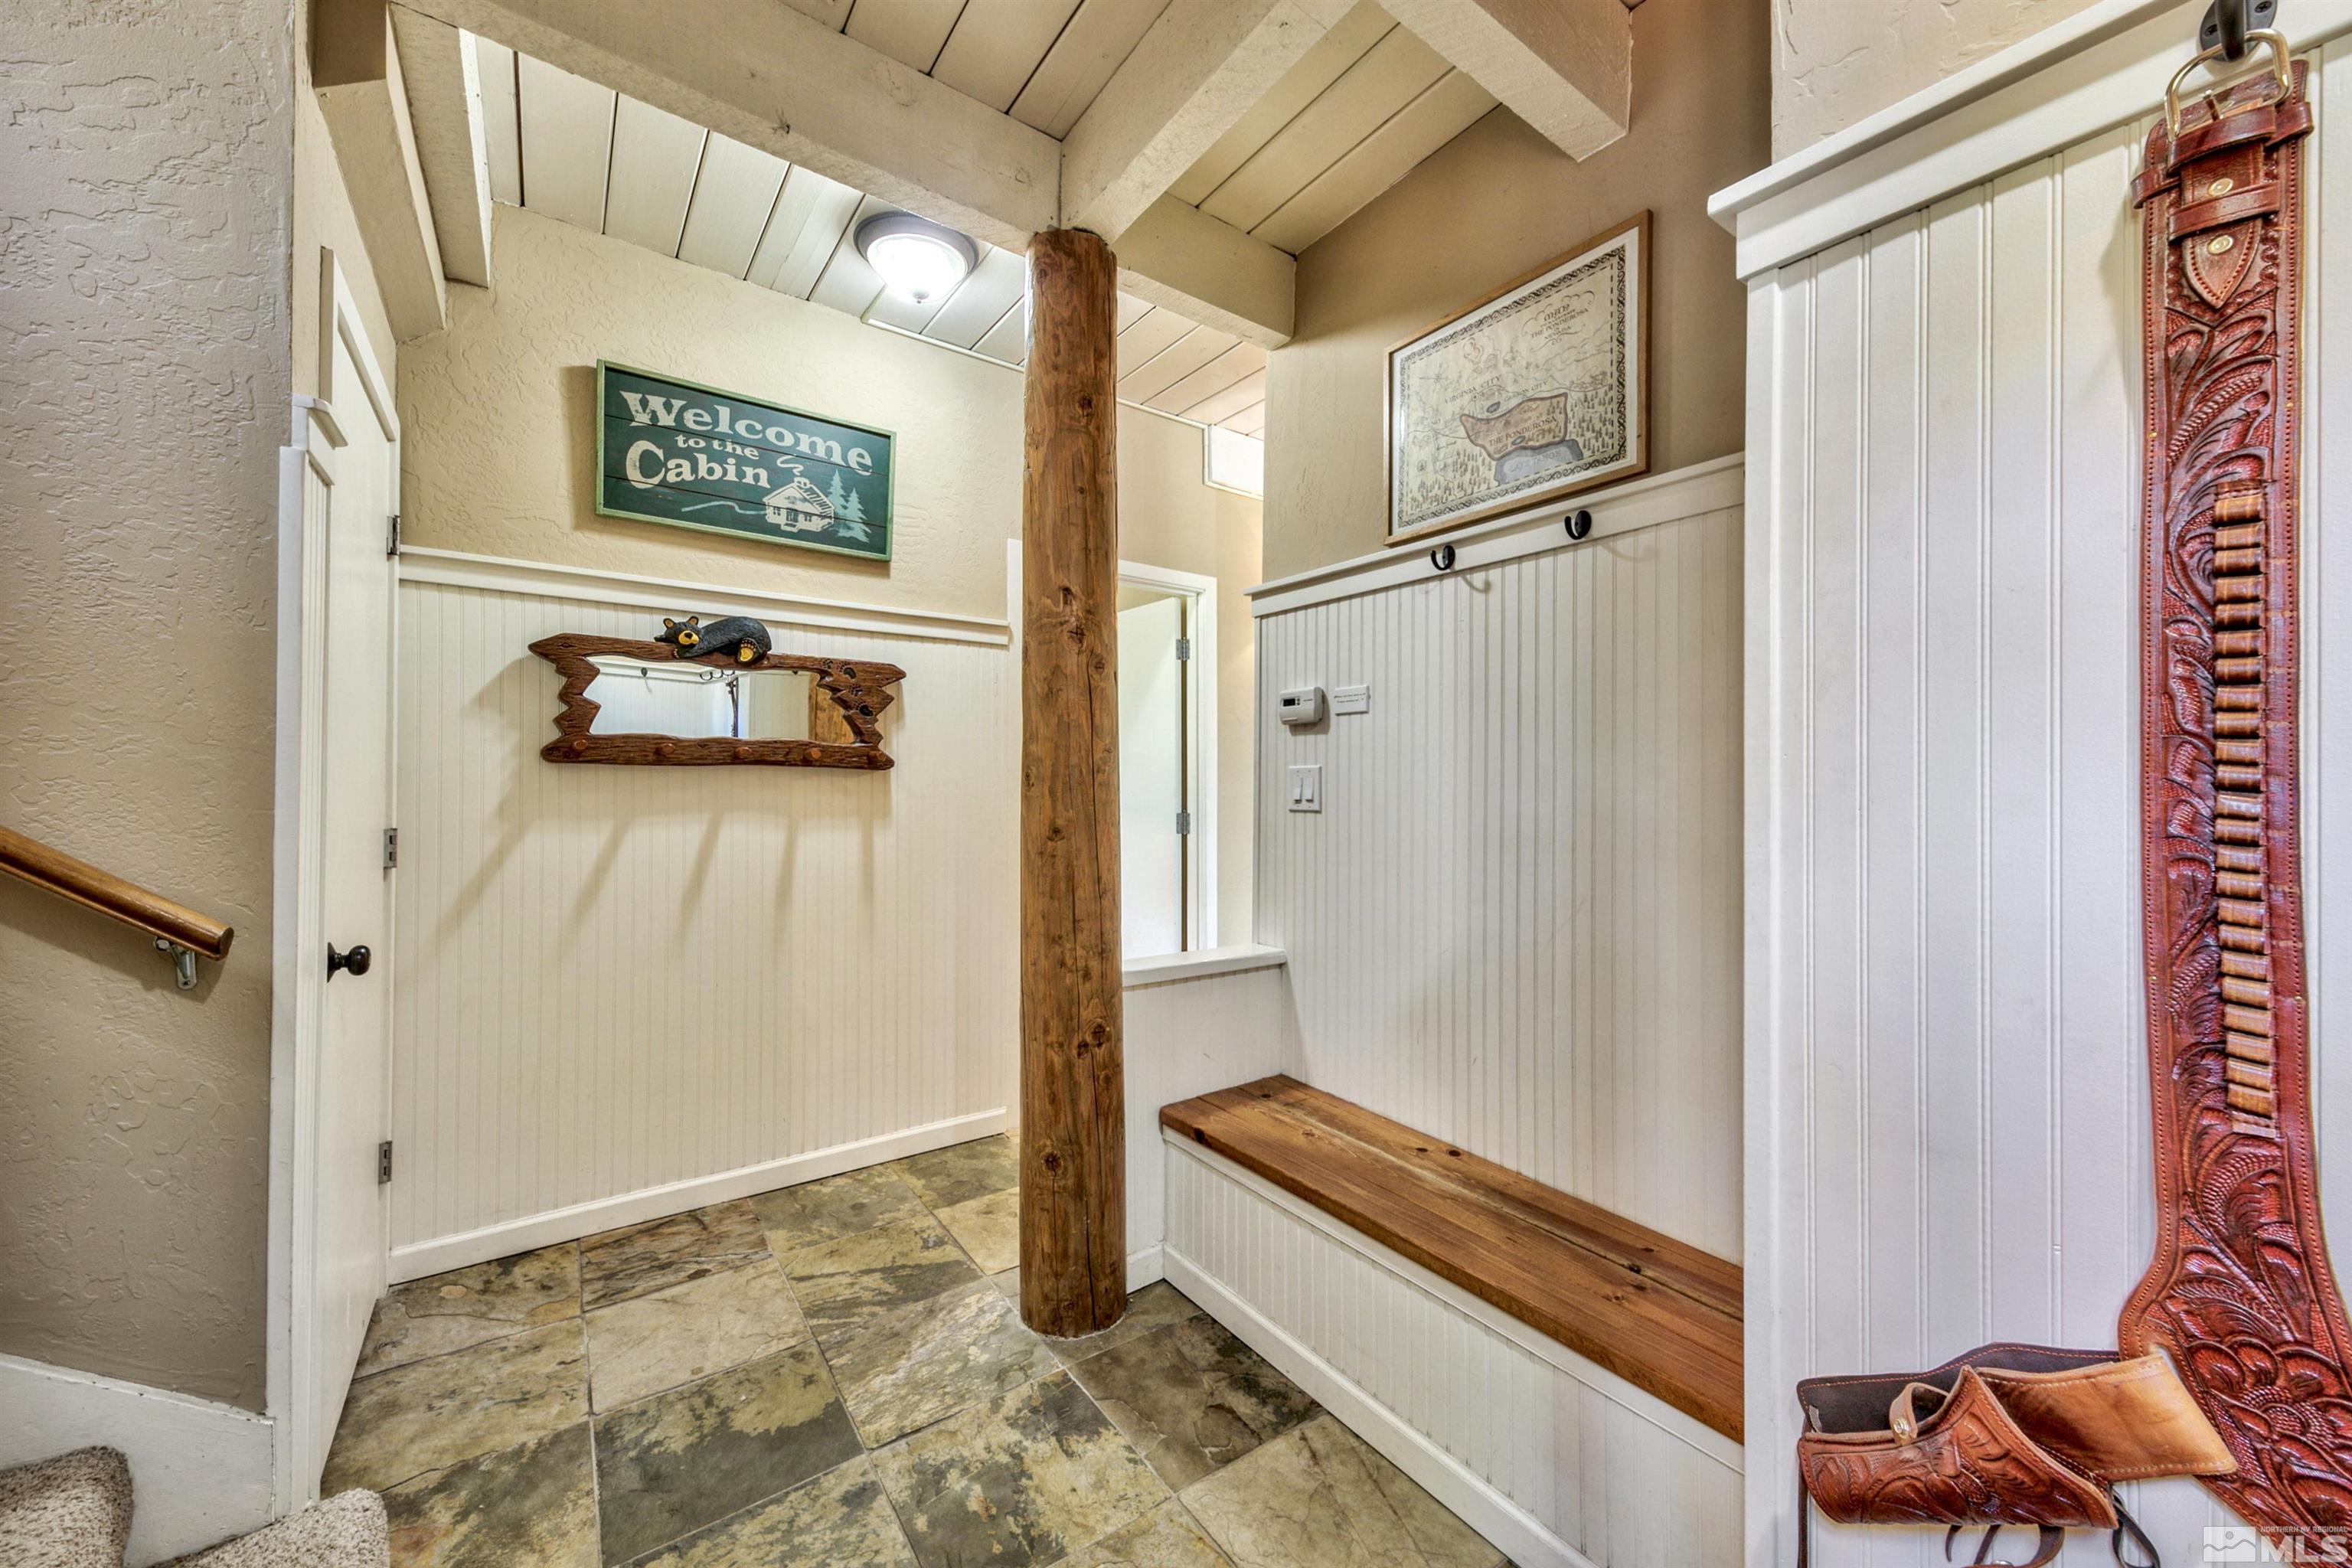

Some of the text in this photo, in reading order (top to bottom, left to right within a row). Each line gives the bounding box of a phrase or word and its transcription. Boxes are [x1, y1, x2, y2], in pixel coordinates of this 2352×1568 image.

[1544, 304, 1570, 322] MAP
[1481, 374, 1502, 389] CITY
[619, 390, 873, 476] Welcome
[1489, 416, 1557, 446] THE PONDEROSA
[675, 434, 760, 459] to the
[626, 439, 771, 489] Cabin
